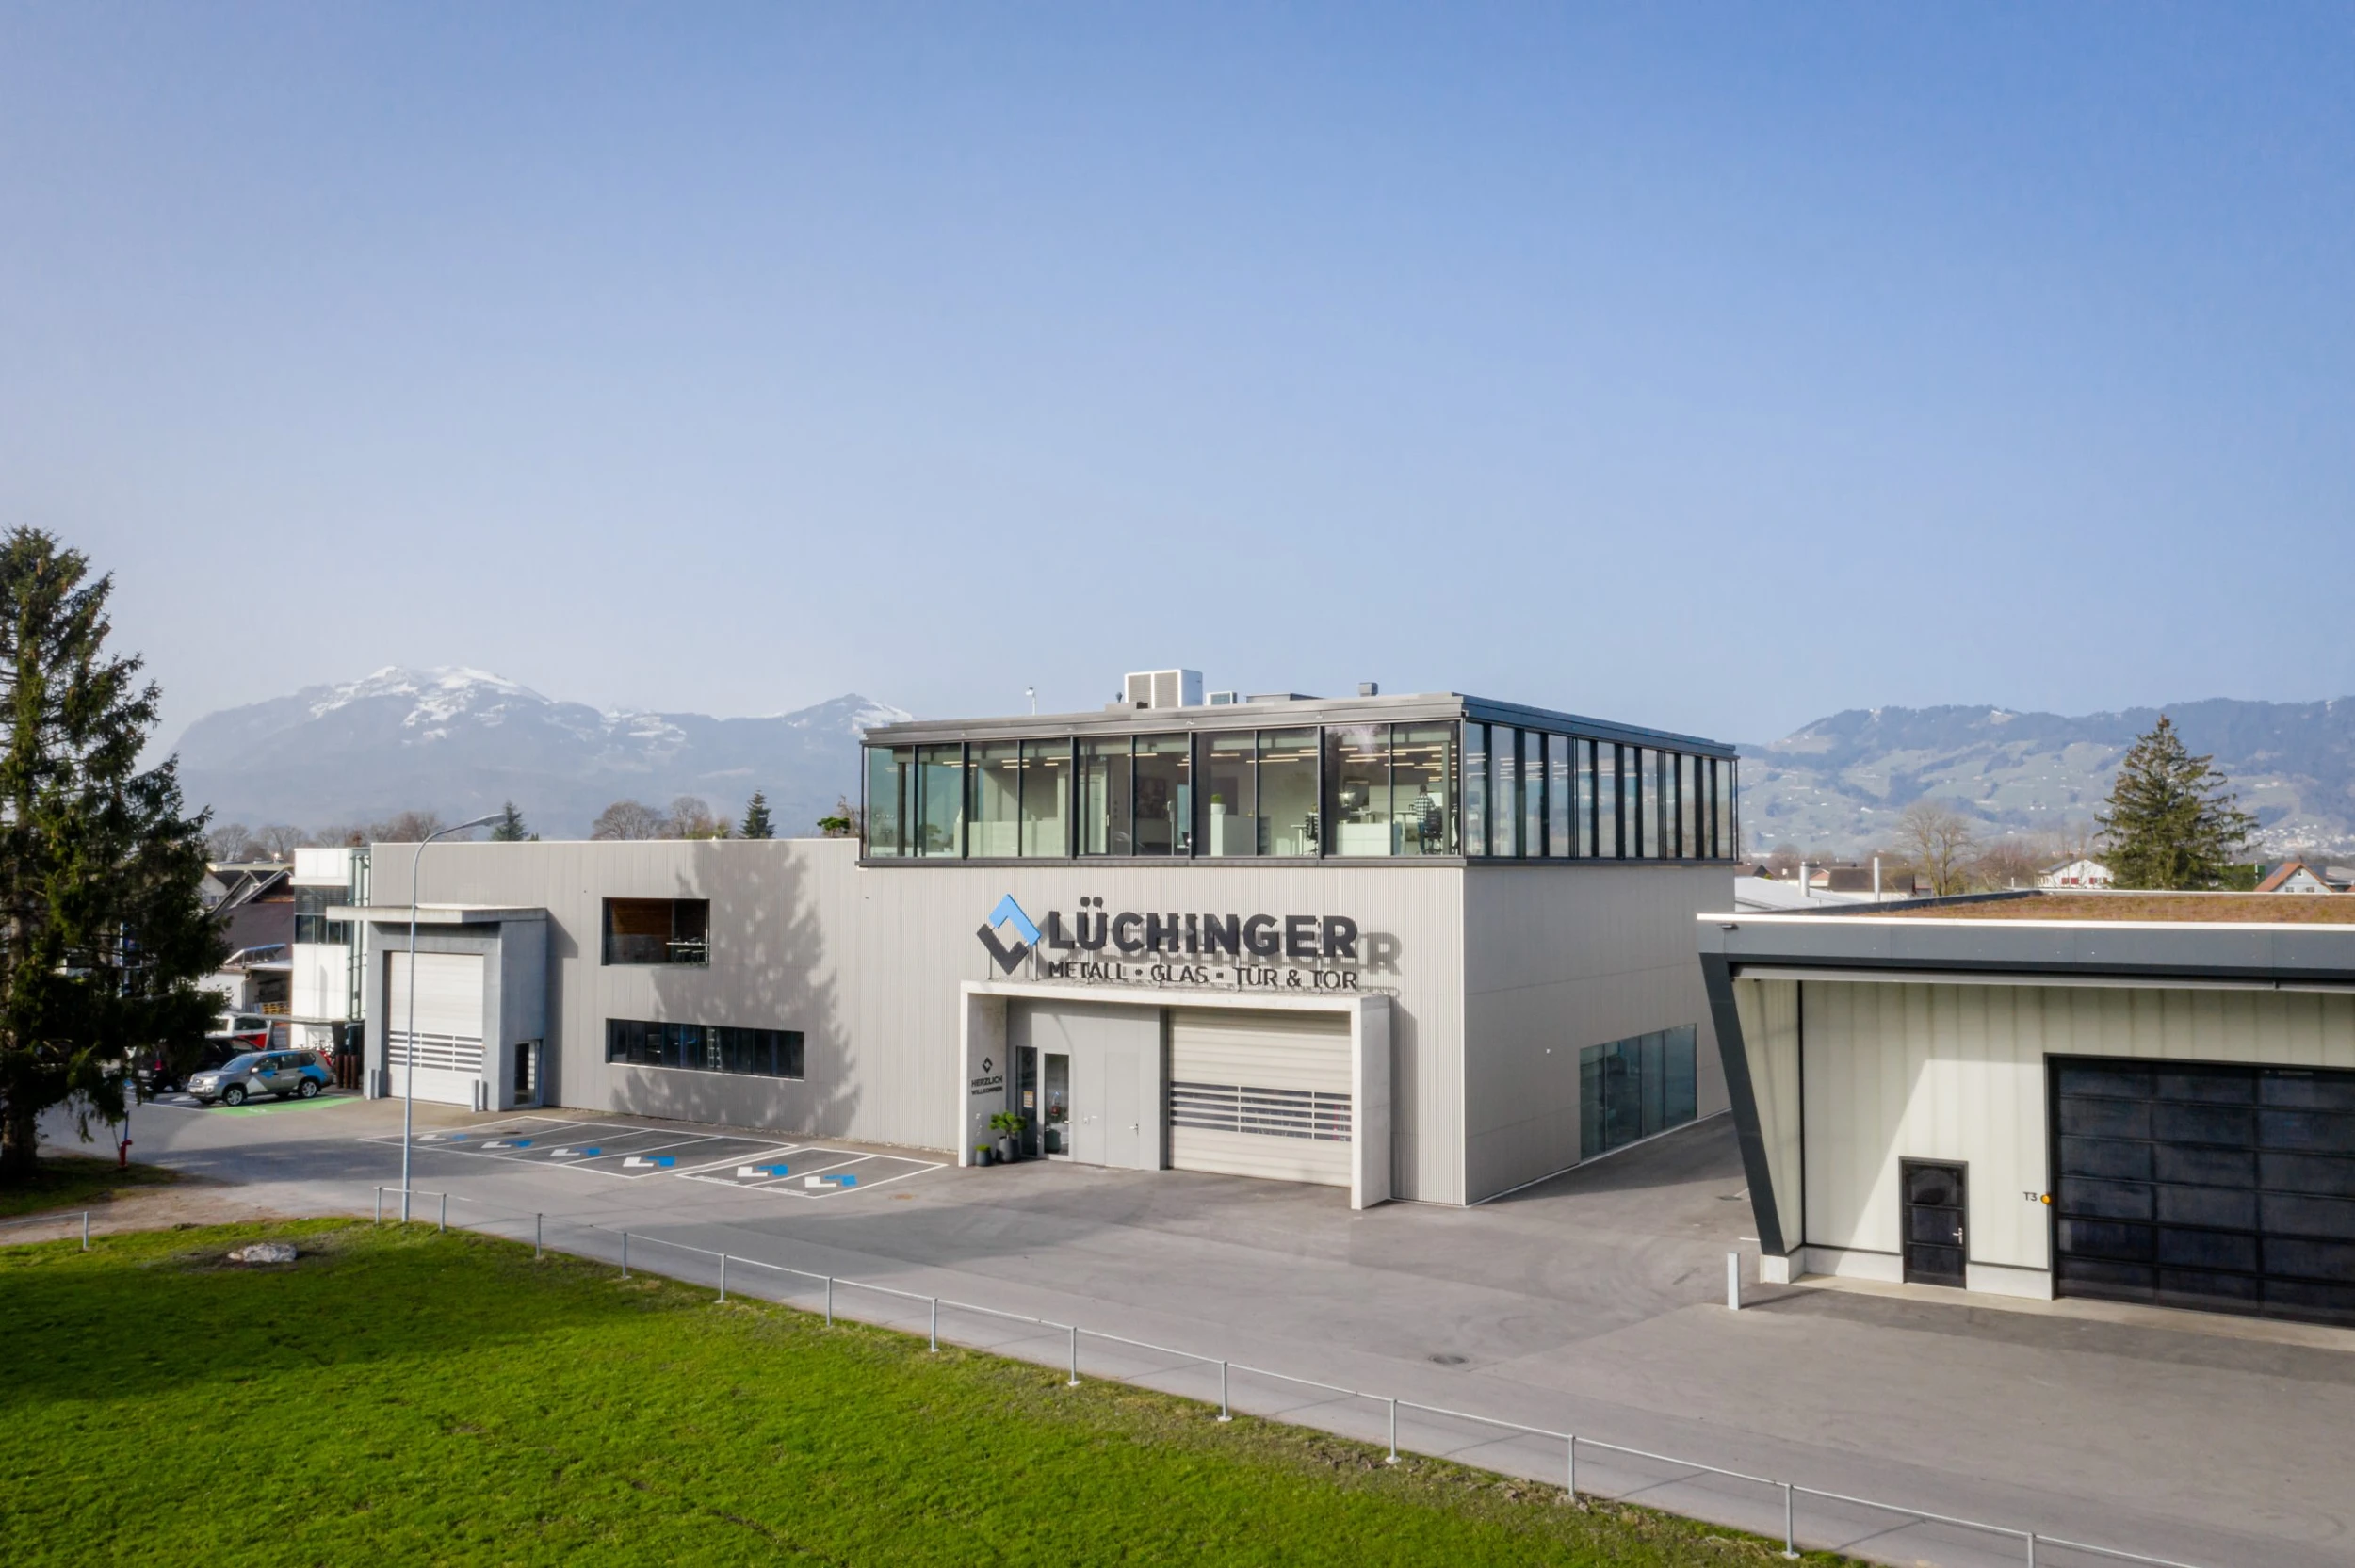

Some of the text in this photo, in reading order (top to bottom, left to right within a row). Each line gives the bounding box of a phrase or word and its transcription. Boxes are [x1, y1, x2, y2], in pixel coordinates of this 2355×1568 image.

[1048, 897, 1358, 959] LÜCHINGER
[1048, 961, 1357, 990] METALL GLAS TÜR & TOR
[971, 1075, 1002, 1087] HERZLICH
[2022, 1191, 2038, 1202] T3
